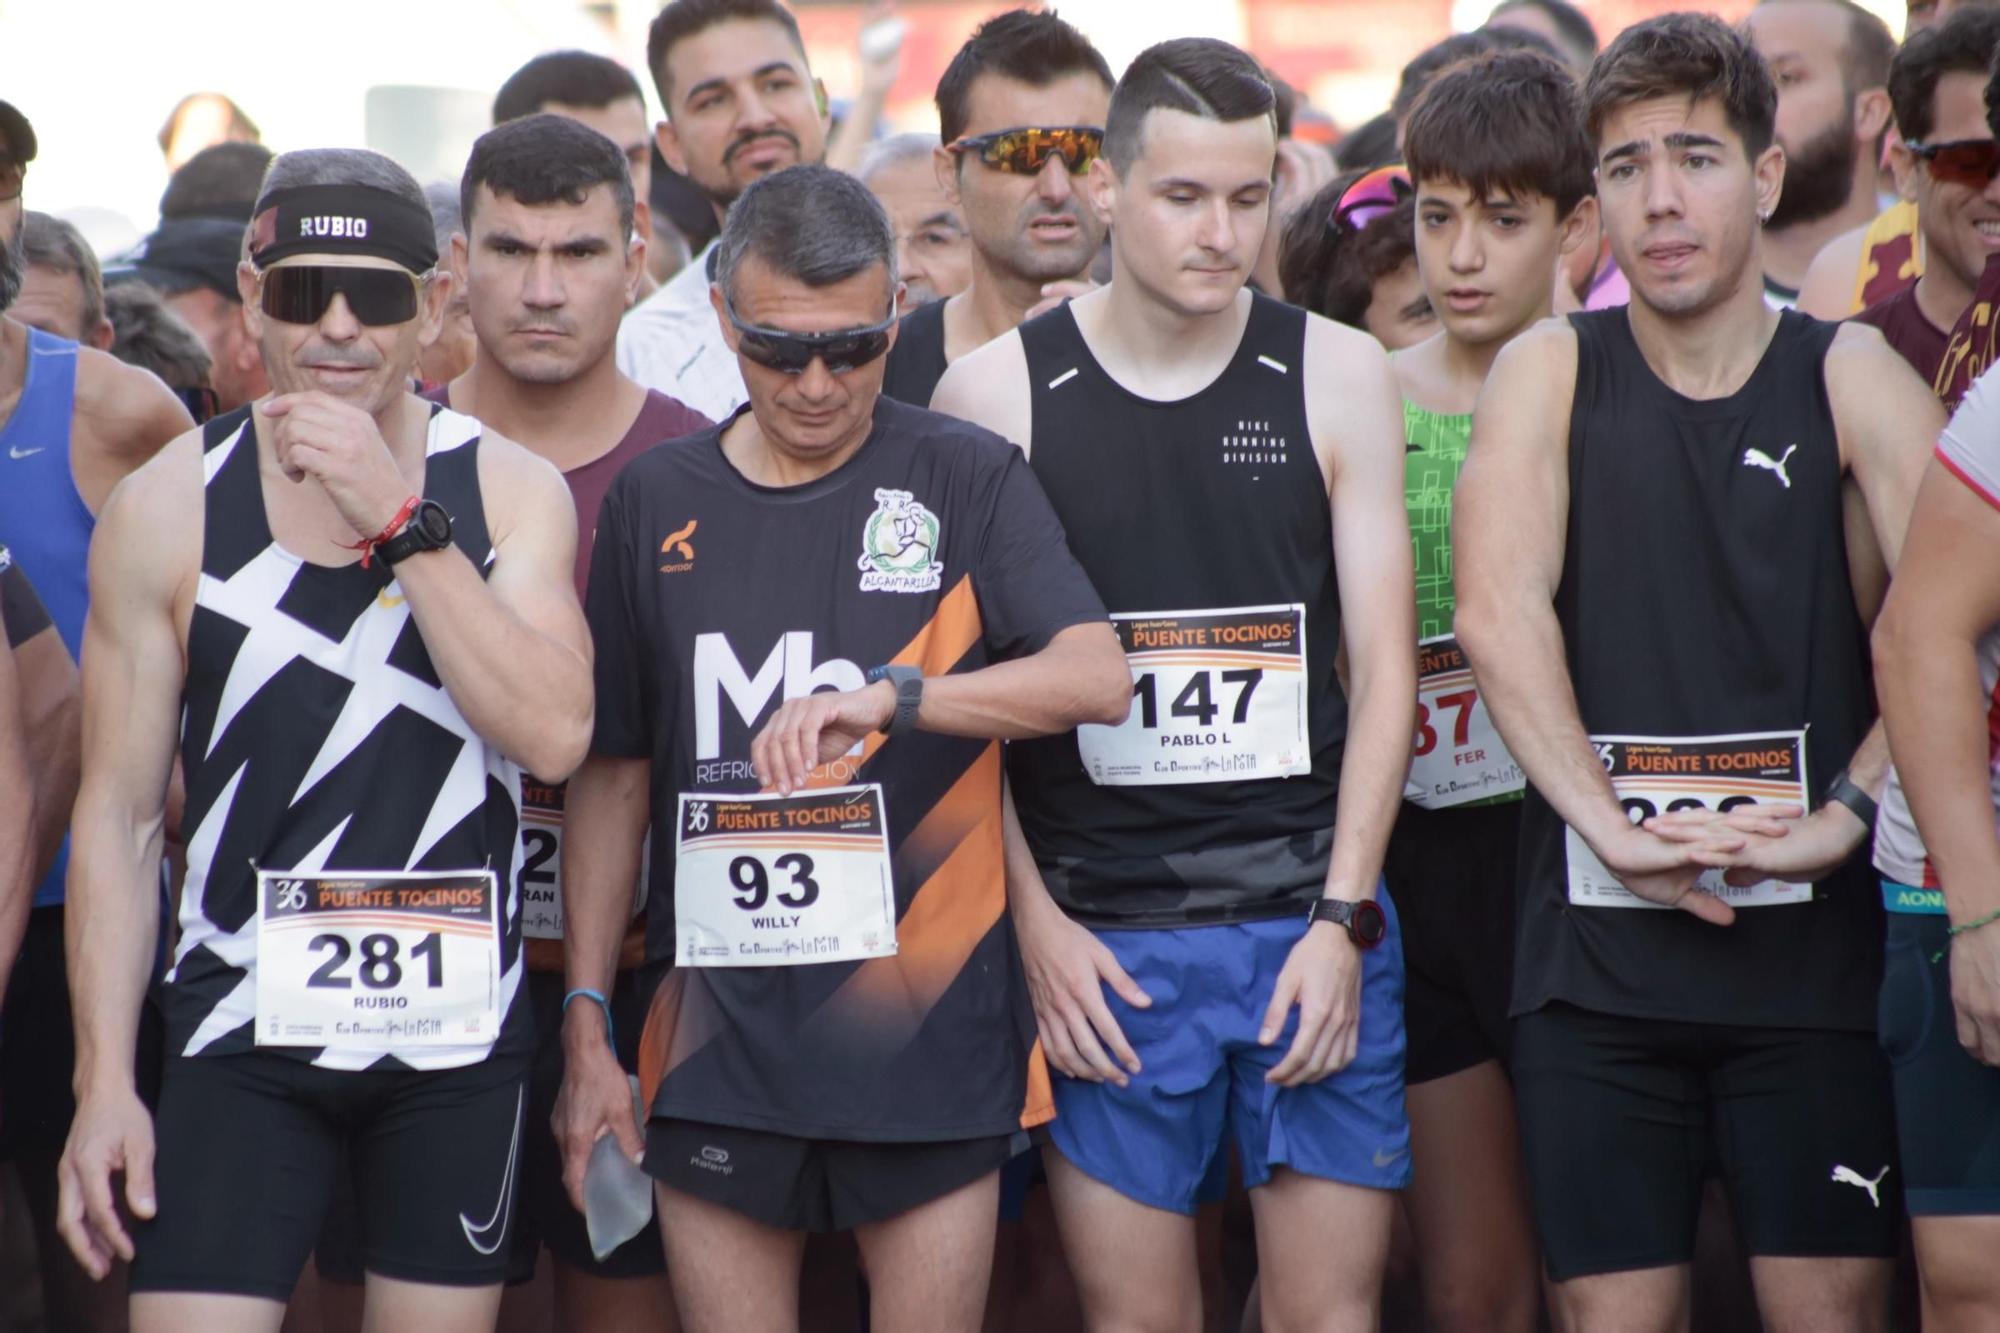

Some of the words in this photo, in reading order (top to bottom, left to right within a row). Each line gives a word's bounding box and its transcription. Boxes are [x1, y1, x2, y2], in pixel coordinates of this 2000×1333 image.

[301, 216, 367, 238] RUBIO
[1239, 421, 1269, 431] NIKE
[1223, 437, 1286, 448] RUNNING
[1224, 453, 1287, 463] DIVISION
[864, 576, 937, 588] ALCANTARILLA
[1133, 629, 1206, 647] PUENTE
[1211, 623, 1292, 643] TOCINOS
[1133, 667, 1263, 729] 147
[1160, 734, 1217, 747] PABLO
[1222, 733, 1231, 744] L
[1453, 749, 1486, 767] FER
[1626, 755, 1701, 771] PUENTE
[1706, 750, 1791, 770] TOCINOS
[688, 802, 710, 832] 36
[717, 812, 780, 829] PUENTE
[784, 804, 872, 826] TOCINOS
[729, 853, 819, 910] 93
[276, 880, 307, 909] 36
[319, 890, 393, 907] PUENTE
[399, 887, 484, 906] TOCINOS
[752, 916, 800, 929] WILLY
[306, 932, 443, 990] 281
[353, 996, 408, 1010] RUBIO
